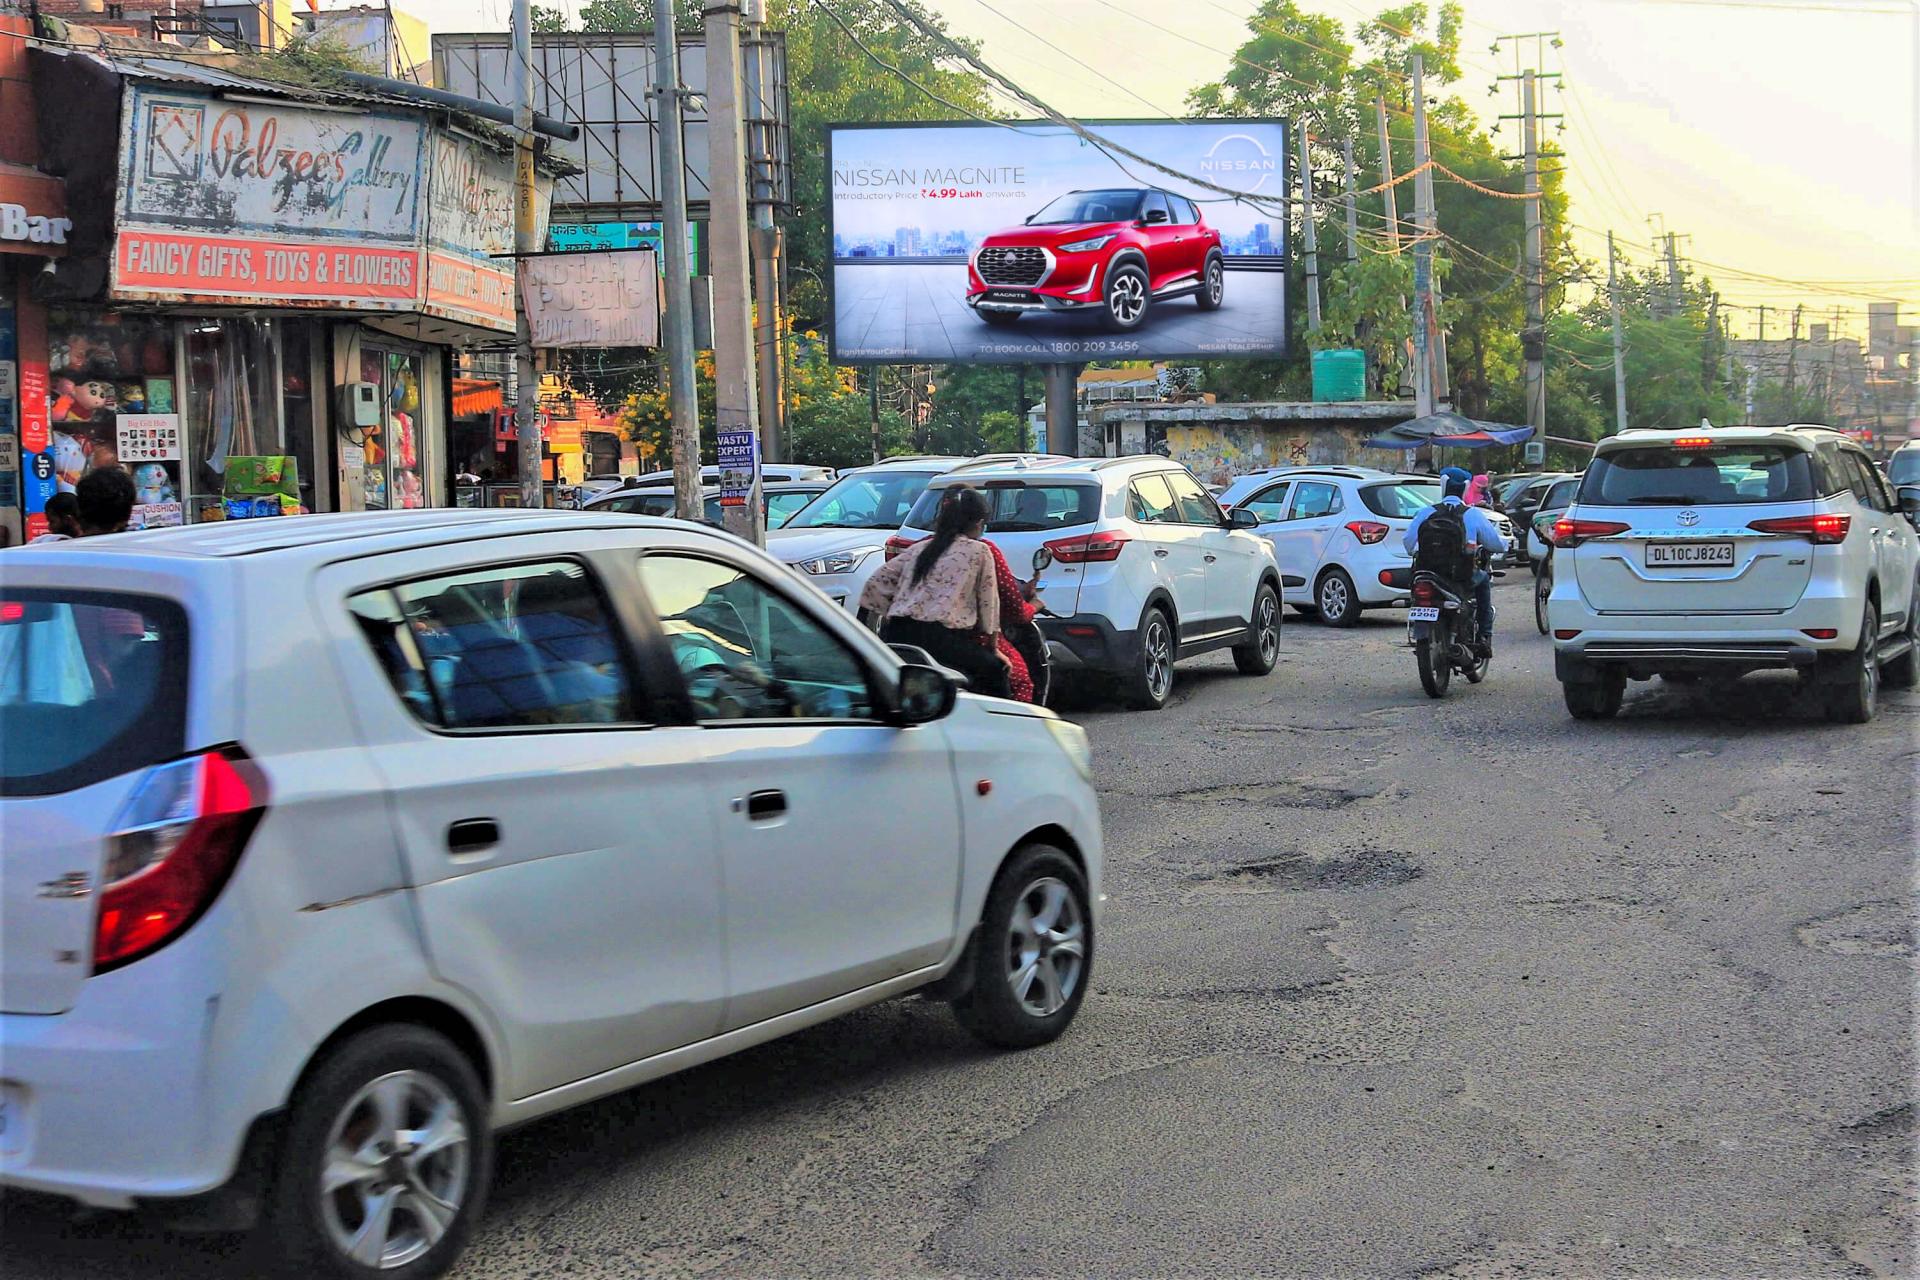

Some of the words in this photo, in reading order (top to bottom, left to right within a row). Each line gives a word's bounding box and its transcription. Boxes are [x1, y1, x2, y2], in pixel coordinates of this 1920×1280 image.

[1200, 160, 1275, 170] NISSAN
[834, 168, 916, 186] NISSAN
[924, 167, 1025, 185] MAGNITE
[834, 191, 892, 200] Introductory
[895, 191, 918, 199] Price
[920, 188, 957, 199] ₹4.99
[959, 190, 983, 199] Lakh
[985, 190, 1026, 199] onwards
[0, 203, 73, 244] Bar
[127, 240, 193, 274] FANCY
[200, 245, 258, 284] GIFTS,
[264, 250, 309, 282] TOYS
[315, 252, 328, 283] &
[334, 254, 411, 286] FLOWERS
[531, 252, 646, 286] NOTARY
[538, 284, 642, 311] PUBLIC
[584, 319, 600, 342] OF
[608, 317, 654, 342] INDIA
[994, 345, 1022, 353] BOOK
[1024, 345, 1048, 353] CALL
[1051, 342, 1079, 352] 1800
[1083, 341, 1106, 352] 209
[1109, 341, 1139, 351] 3456
[717, 435, 749, 445] VASTU
[717, 446, 752, 456] EXPERT
[38, 455, 50, 478] Jio
[145, 503, 181, 513] CUSHION
[1654, 546, 1731, 561] DL10CJ8243
